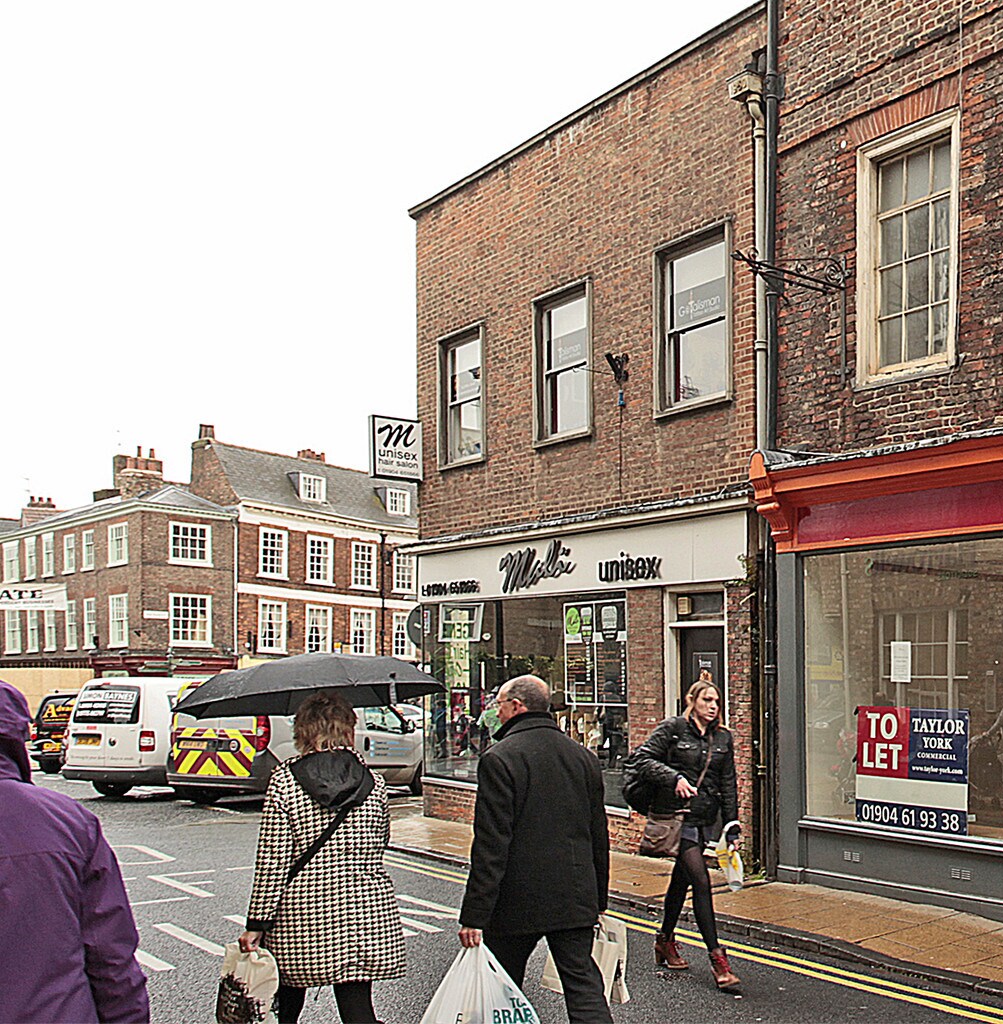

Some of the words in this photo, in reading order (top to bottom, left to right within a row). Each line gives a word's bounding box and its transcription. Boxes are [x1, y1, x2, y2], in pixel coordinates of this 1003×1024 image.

[378, 448, 418, 462] unisex
[378, 457, 394, 466] hair
[395, 460, 419, 469] salon
[598, 551, 663, 583] unisex
[0, 589, 43, 600] ATE
[865, 710, 898, 740] TO
[911, 717, 966, 735] TAYLOR
[922, 736, 953, 750] YORK
[862, 741, 903, 770] LET
[916, 751, 957, 761] COMMERCIAL
[911, 765, 964, 775] www.taylor-york.com
[861, 803, 899, 825] 01904
[901, 808, 916, 827] 61
[919, 810, 937, 829] 93
[940, 812, 960, 831] 38
